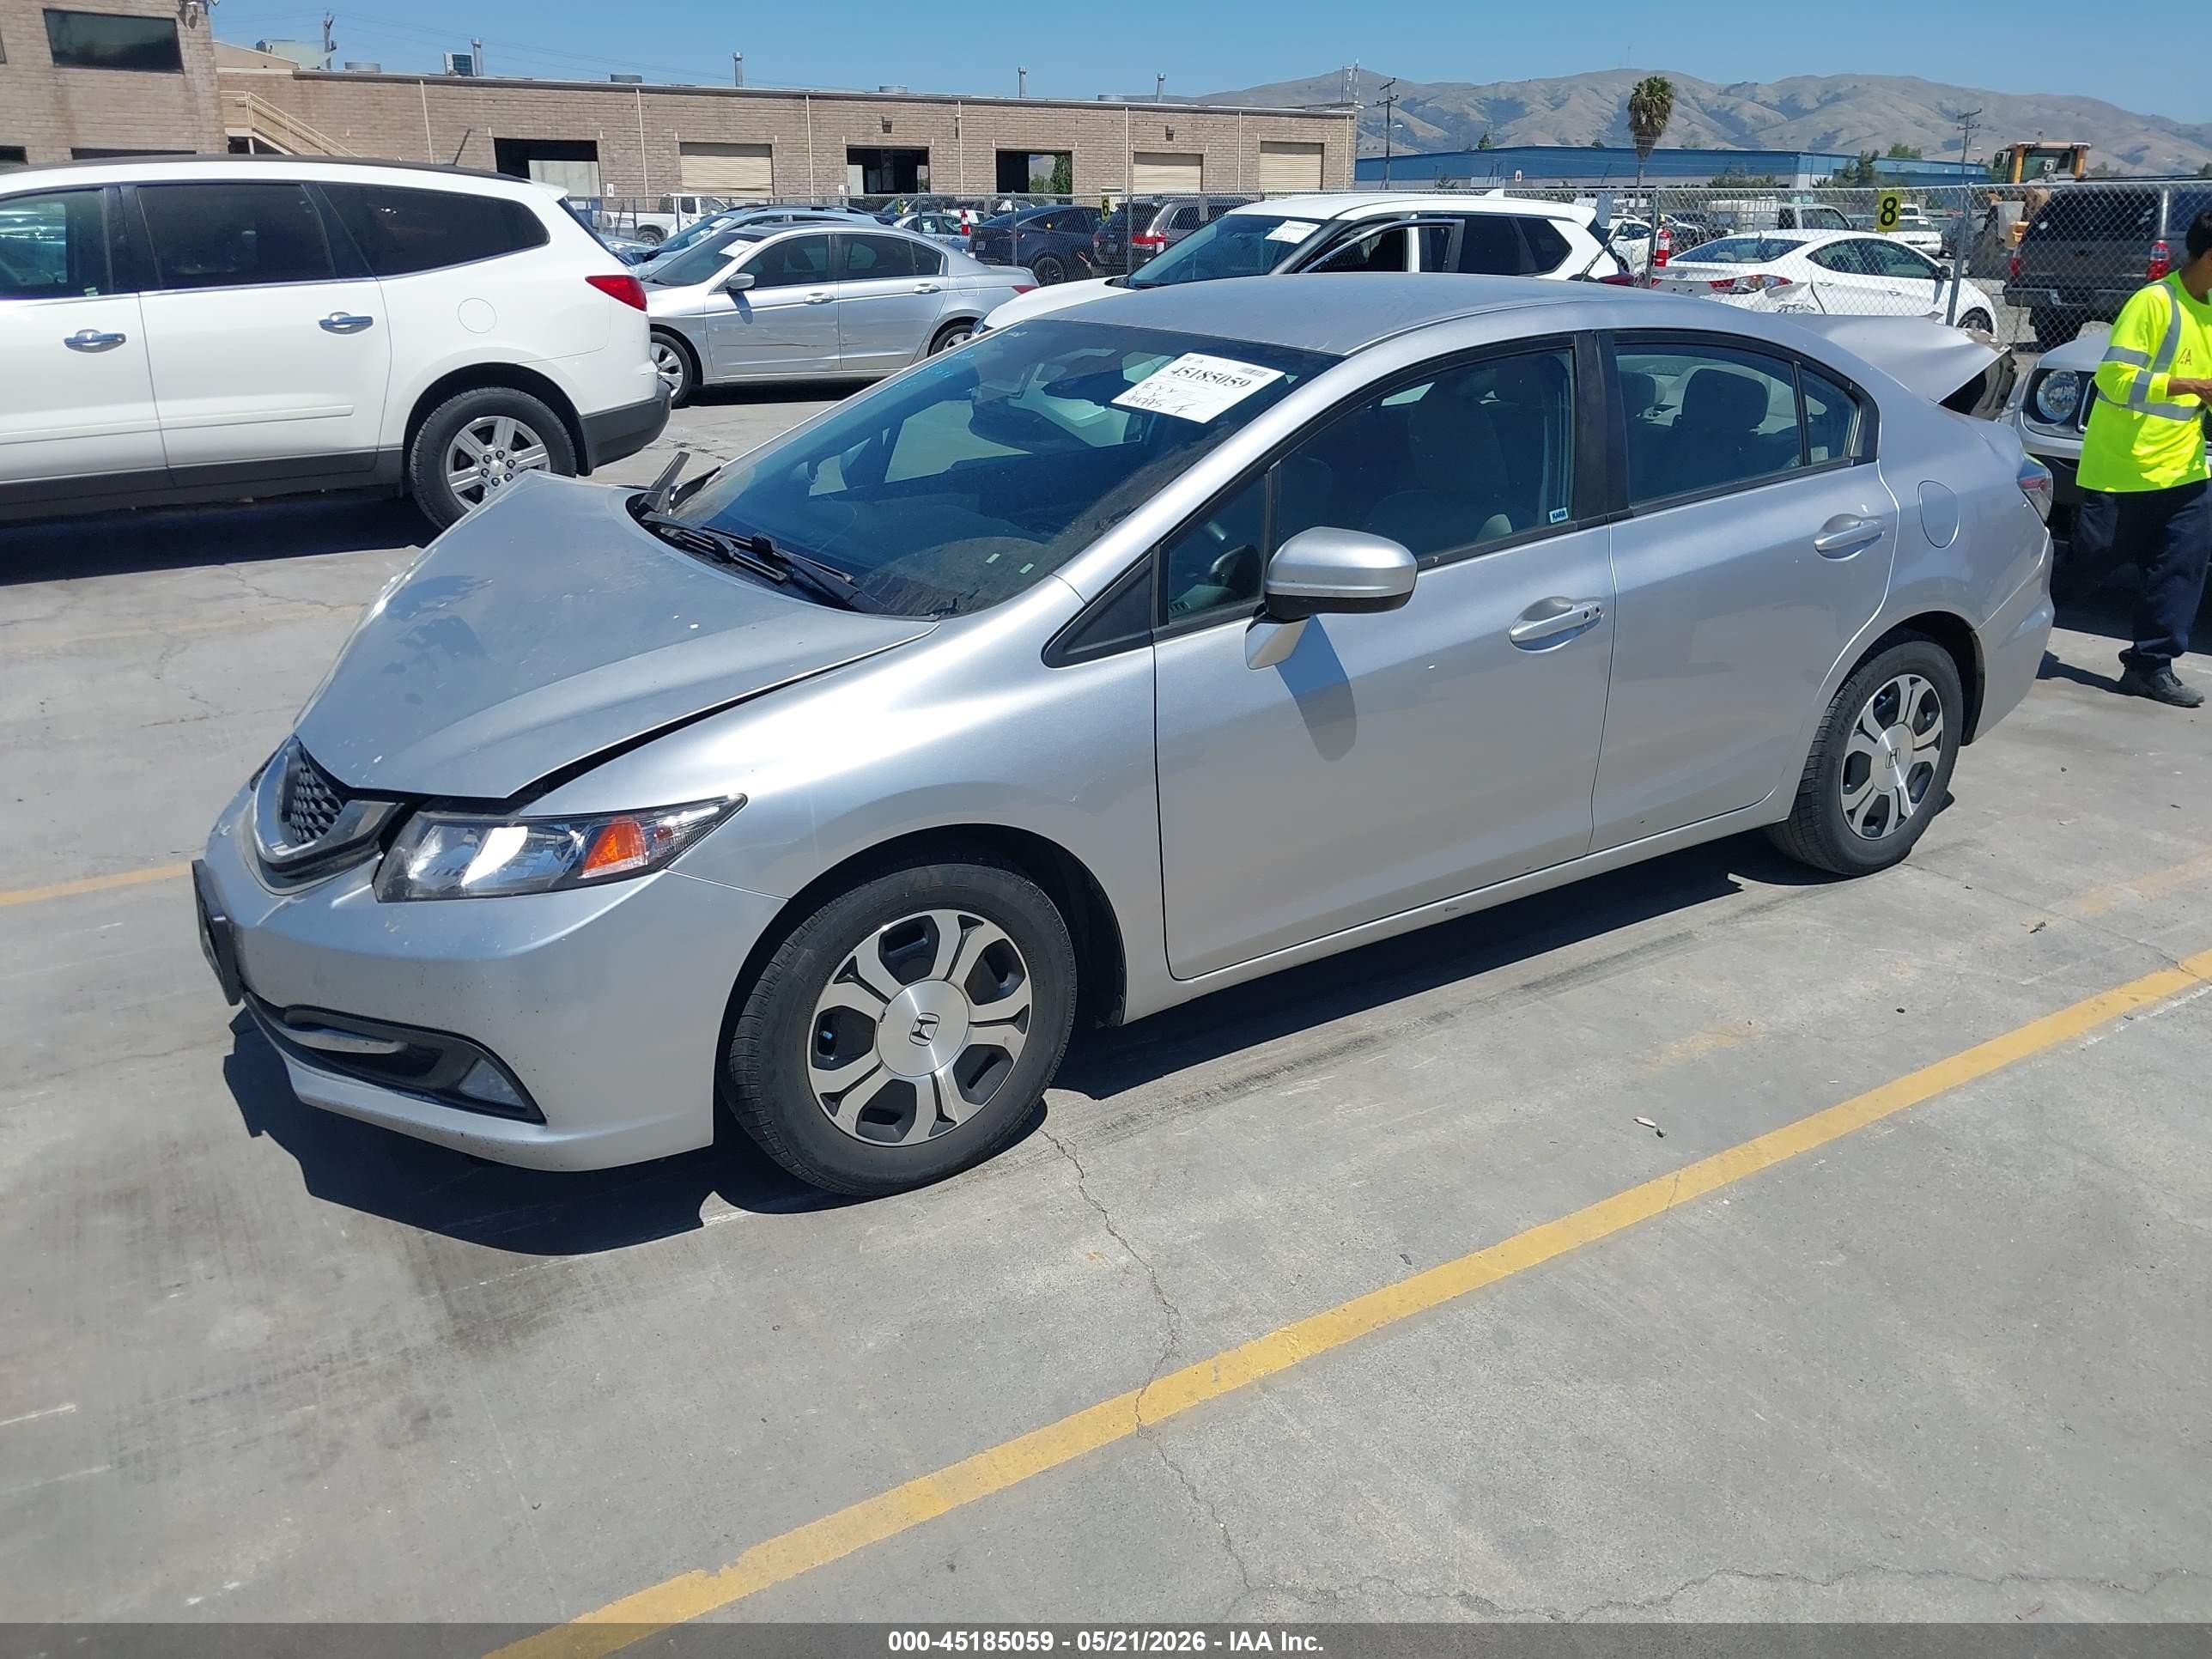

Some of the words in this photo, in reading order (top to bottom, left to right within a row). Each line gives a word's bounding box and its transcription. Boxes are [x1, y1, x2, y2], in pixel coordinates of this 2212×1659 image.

[2044, 159, 2055, 172] 5
[1102, 198, 1109, 216] 6
[1881, 197, 1898, 227] 8
[1170, 366, 1252, 389] 45185059
